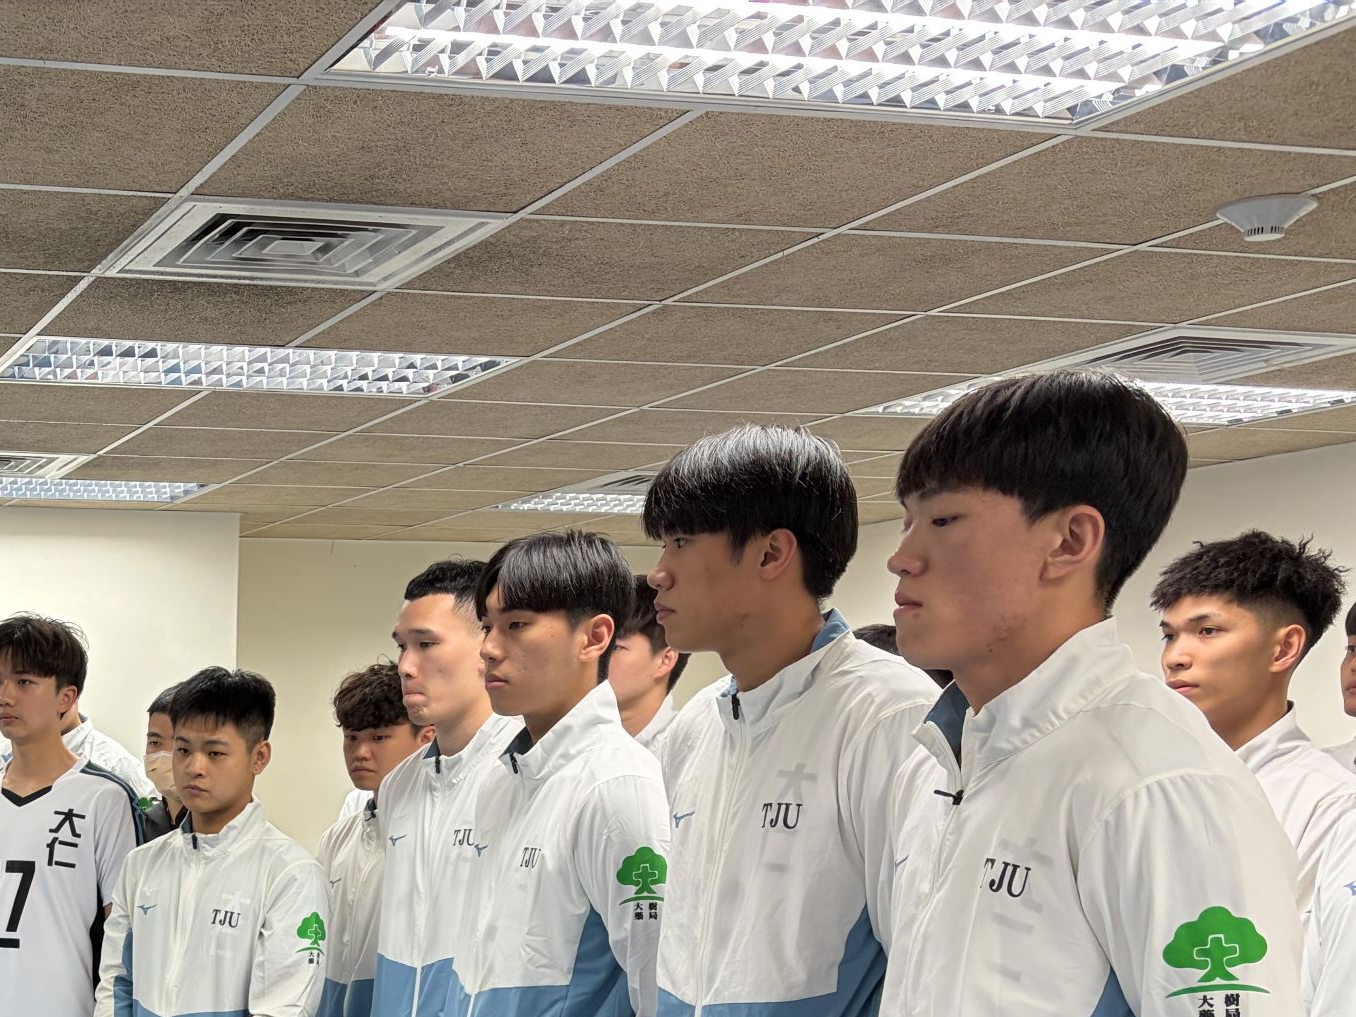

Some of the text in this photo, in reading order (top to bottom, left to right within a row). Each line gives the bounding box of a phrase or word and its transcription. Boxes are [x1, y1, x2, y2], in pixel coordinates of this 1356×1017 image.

[761, 802, 803, 829] TJU
[46, 808, 86, 869] 大仁
[452, 828, 475, 846] TJU
[520, 847, 542, 869] TJU
[980, 857, 1032, 898] TJU
[211, 908, 241, 928] TJU
